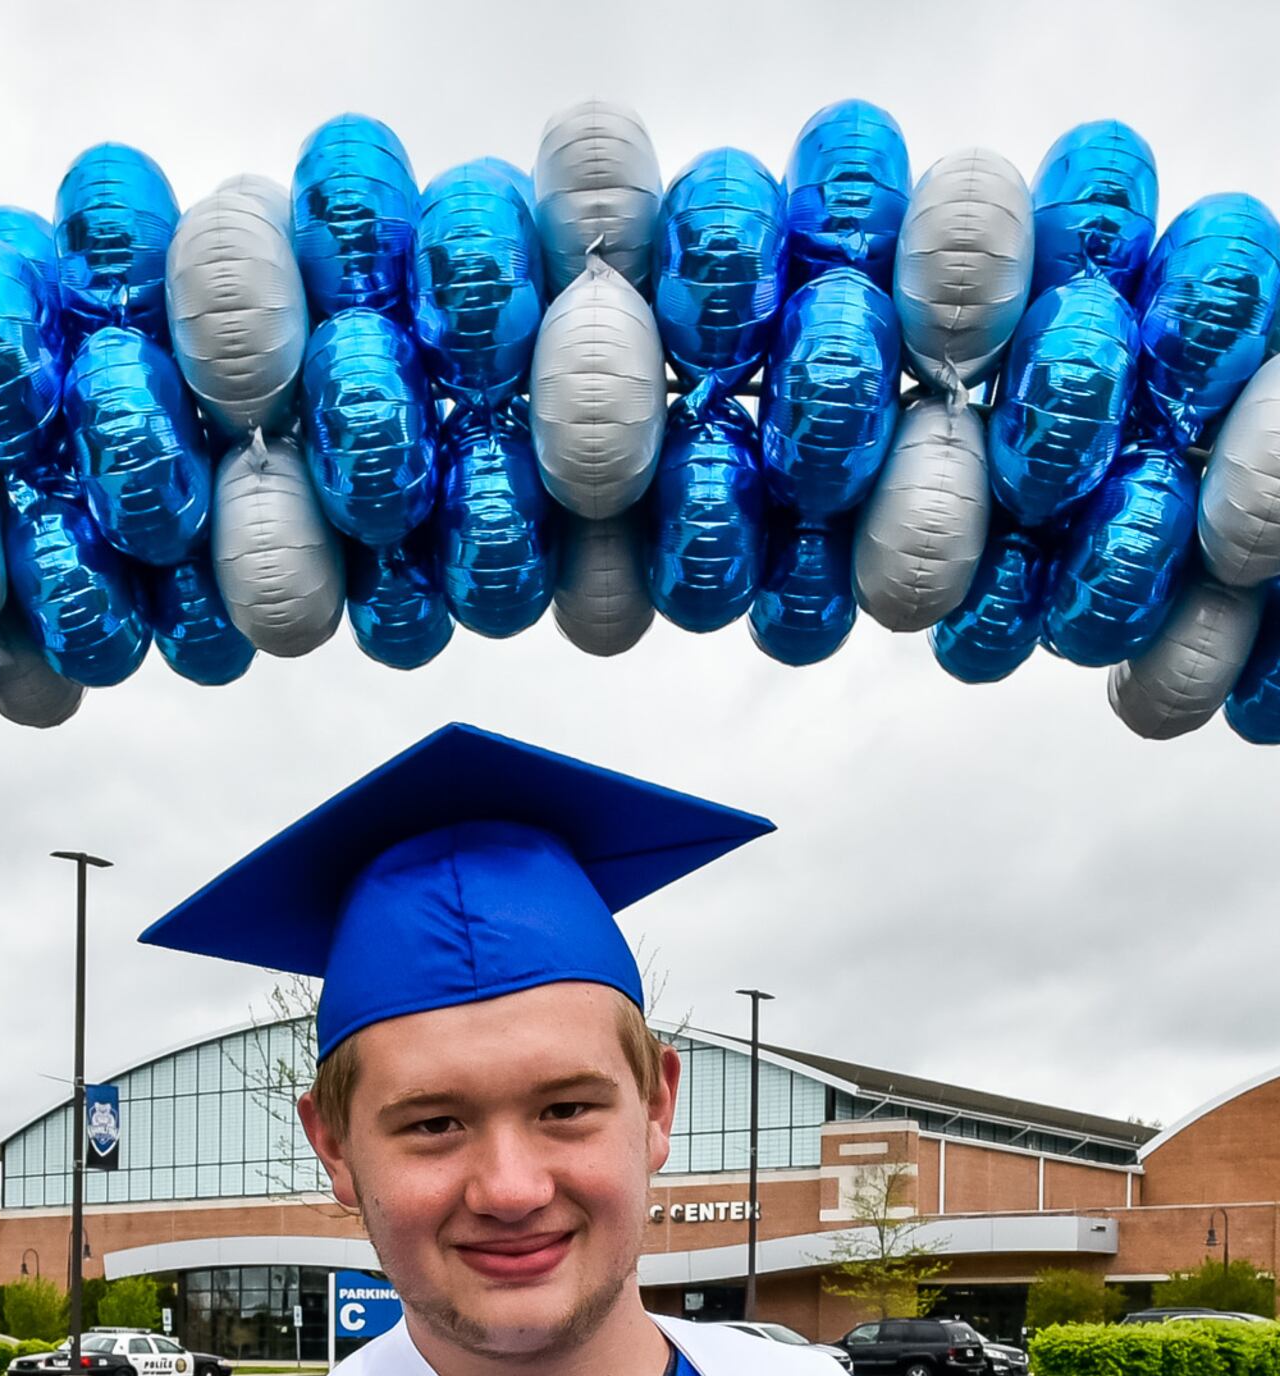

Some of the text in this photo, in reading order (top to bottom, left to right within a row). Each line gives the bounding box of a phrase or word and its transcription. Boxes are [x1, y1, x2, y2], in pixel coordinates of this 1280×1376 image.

[670, 1201, 761, 1222] CENTER
[339, 1288, 399, 1300] PARKING
[340, 1302, 366, 1331] C
[144, 1360, 173, 1369] POLICE
